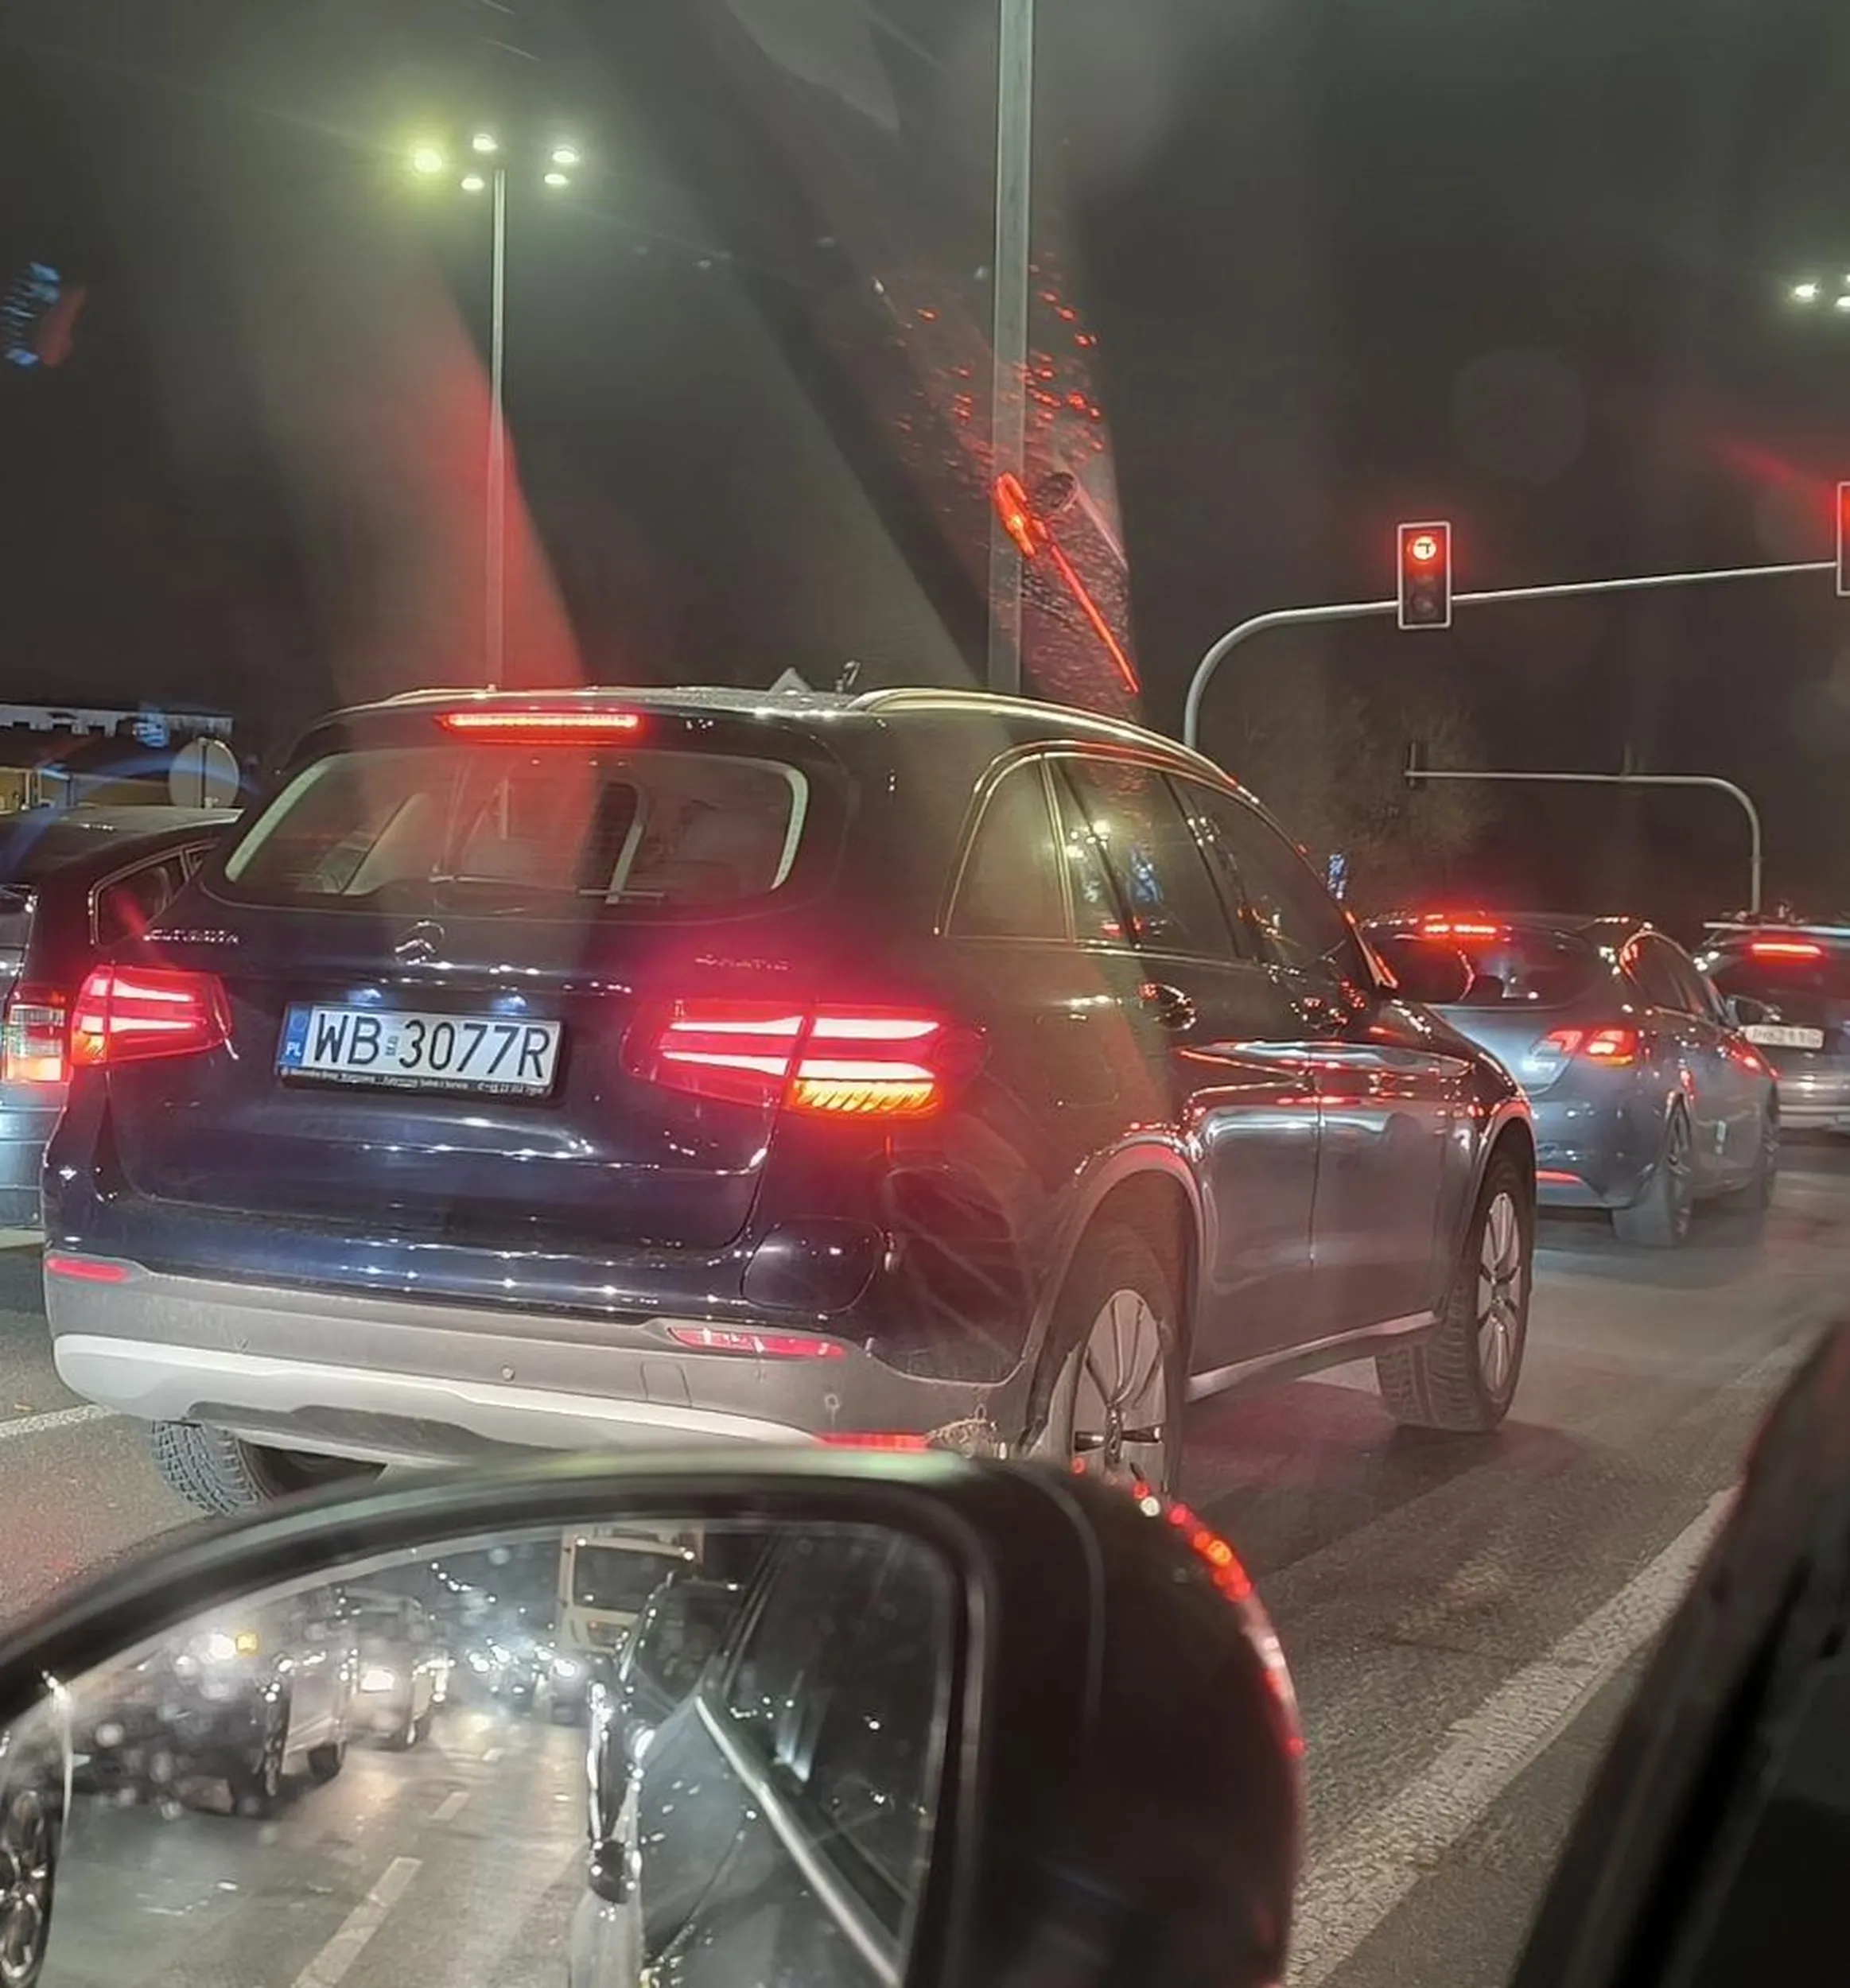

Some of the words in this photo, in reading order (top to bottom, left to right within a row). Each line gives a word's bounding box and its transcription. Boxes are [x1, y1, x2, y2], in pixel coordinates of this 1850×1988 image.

[284, 1041, 301, 1058] PL
[313, 1013, 382, 1064] WB
[398, 1019, 550, 1077] 3077R
